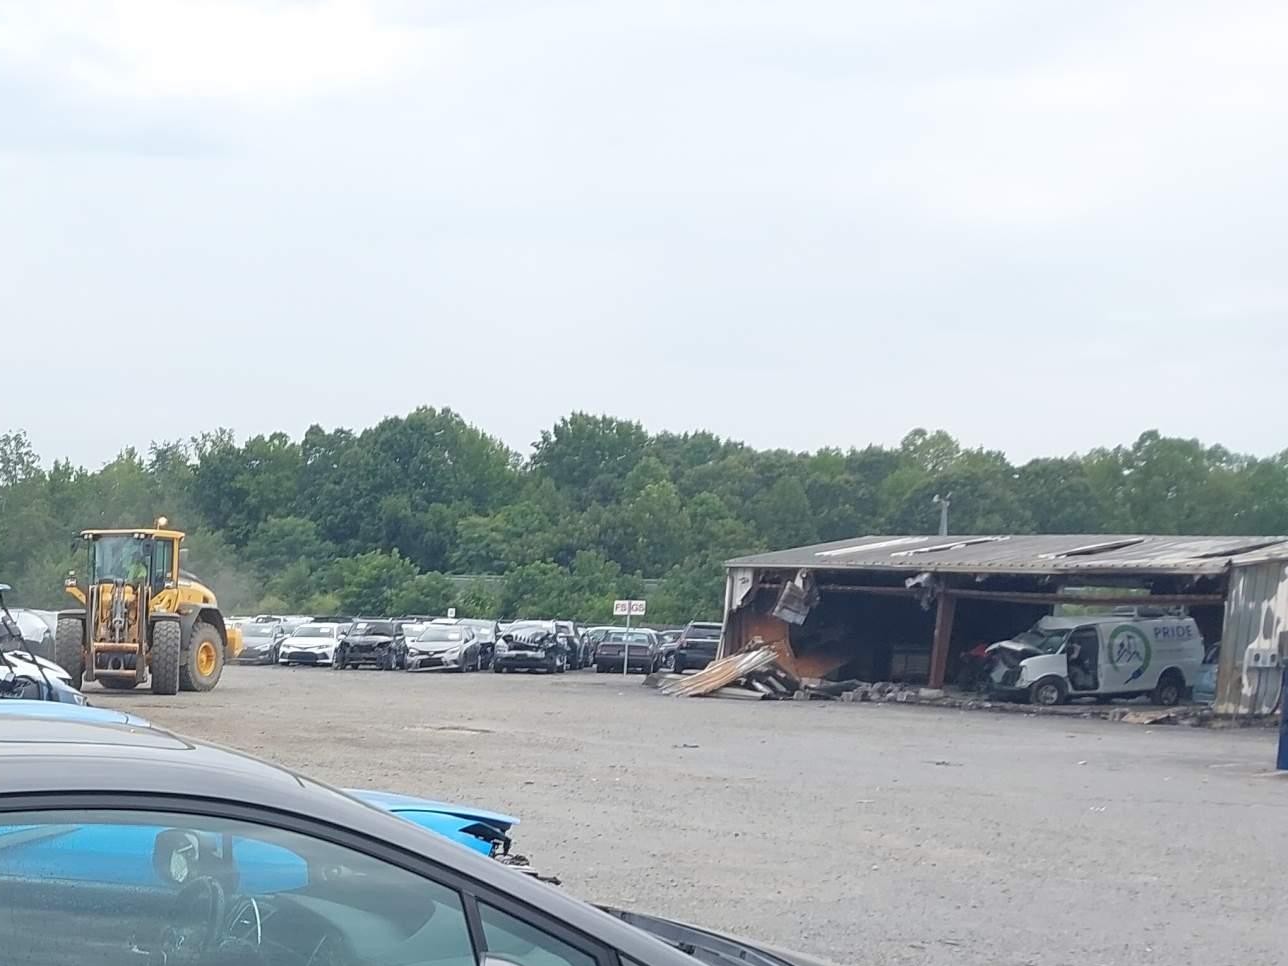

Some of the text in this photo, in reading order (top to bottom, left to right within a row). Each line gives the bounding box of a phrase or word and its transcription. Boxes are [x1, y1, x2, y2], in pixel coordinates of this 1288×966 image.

[615, 603, 645, 612] FS GS
[1153, 625, 1192, 639] PRIDE
